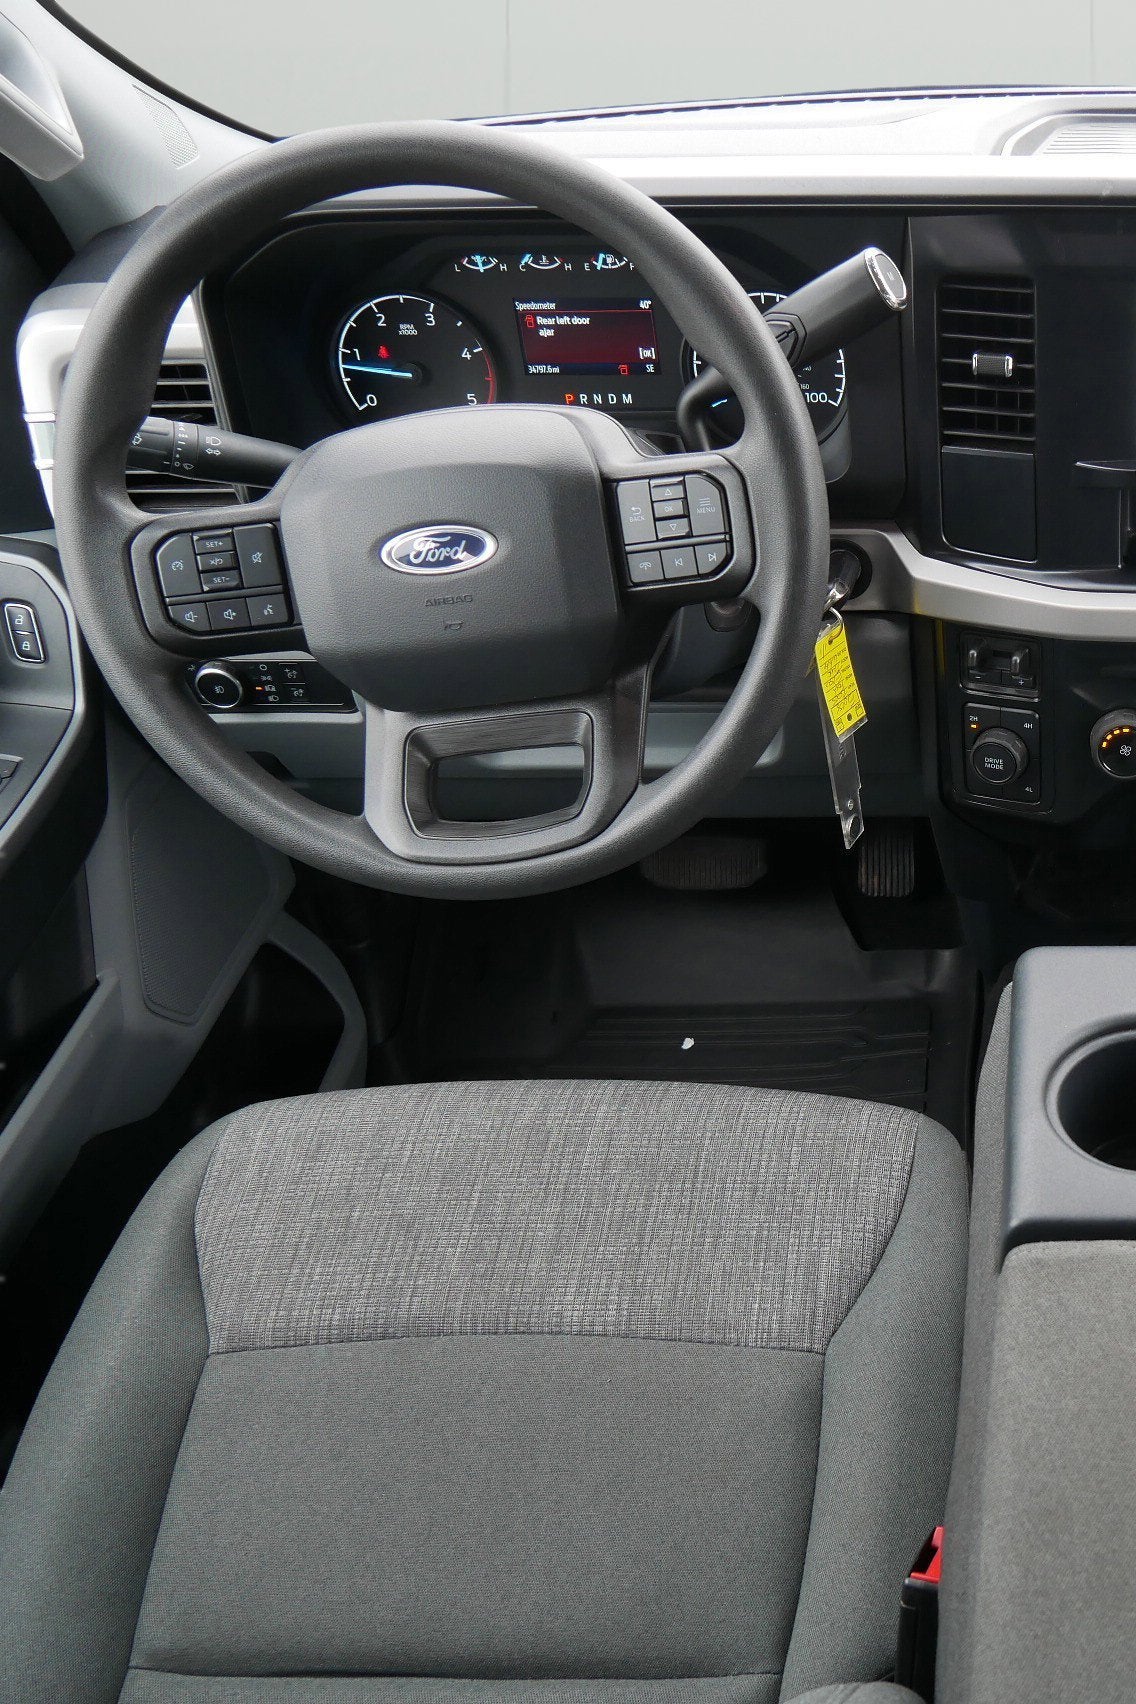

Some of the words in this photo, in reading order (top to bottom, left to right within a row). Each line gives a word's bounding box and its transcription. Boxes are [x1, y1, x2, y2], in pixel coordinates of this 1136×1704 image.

[455, 264, 461, 272] L
[515, 301, 556, 311] Speedometer
[376, 314, 386, 326] 2
[425, 313, 436, 326] 3
[536, 316, 555, 325] Rear
[556, 315, 571, 325] left
[571, 315, 590, 325] door
[539, 328, 555, 337] ajar
[353, 349, 361, 361] 1
[461, 348, 472, 360] 4
[646, 364, 655, 373] SE
[366, 394, 377, 407] 0
[466, 393, 477, 406] 5
[565, 393, 574, 405] P
[579, 394, 588, 404] R
[593, 394, 602, 404] N
[608, 394, 617, 404] D
[622, 393, 633, 404] M
[805, 392, 828, 403] 100
[664, 505, 674, 513] OK
[410, 536, 467, 564] Ford
[425, 594, 473, 607] AIRBAG
[984, 757, 1004, 765] DRIVE
